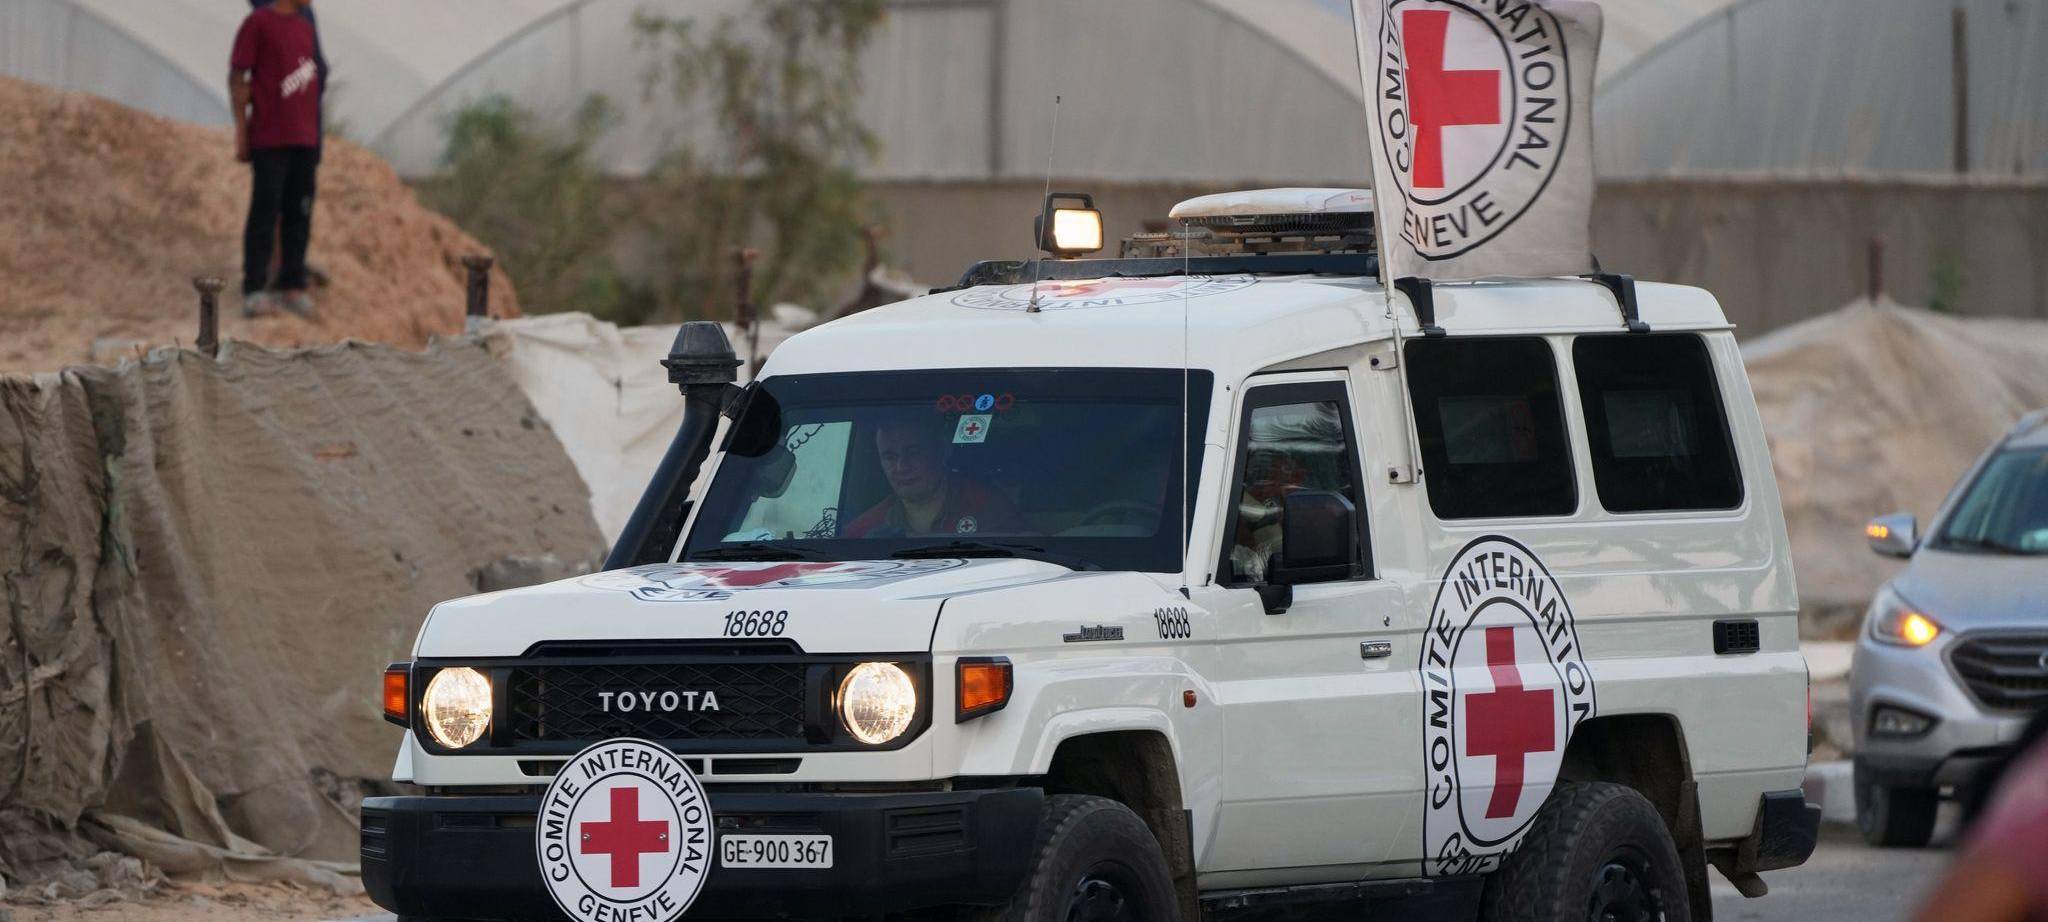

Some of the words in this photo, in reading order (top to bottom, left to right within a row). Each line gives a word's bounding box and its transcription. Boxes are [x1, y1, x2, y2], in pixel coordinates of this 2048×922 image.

[1403, 190, 1503, 248] ENEVE
[722, 609, 788, 637] 18688
[1153, 606, 1191, 639] 18688
[1428, 608, 1456, 810] COMITE
[1453, 551, 1591, 724] INTERNATION
[598, 690, 720, 712] TOYOTA
[545, 776, 580, 882] COMITE
[580, 748, 705, 877] INTERNATIONAL
[793, 839, 829, 863] 367
[578, 889, 676, 922] GENEVE
